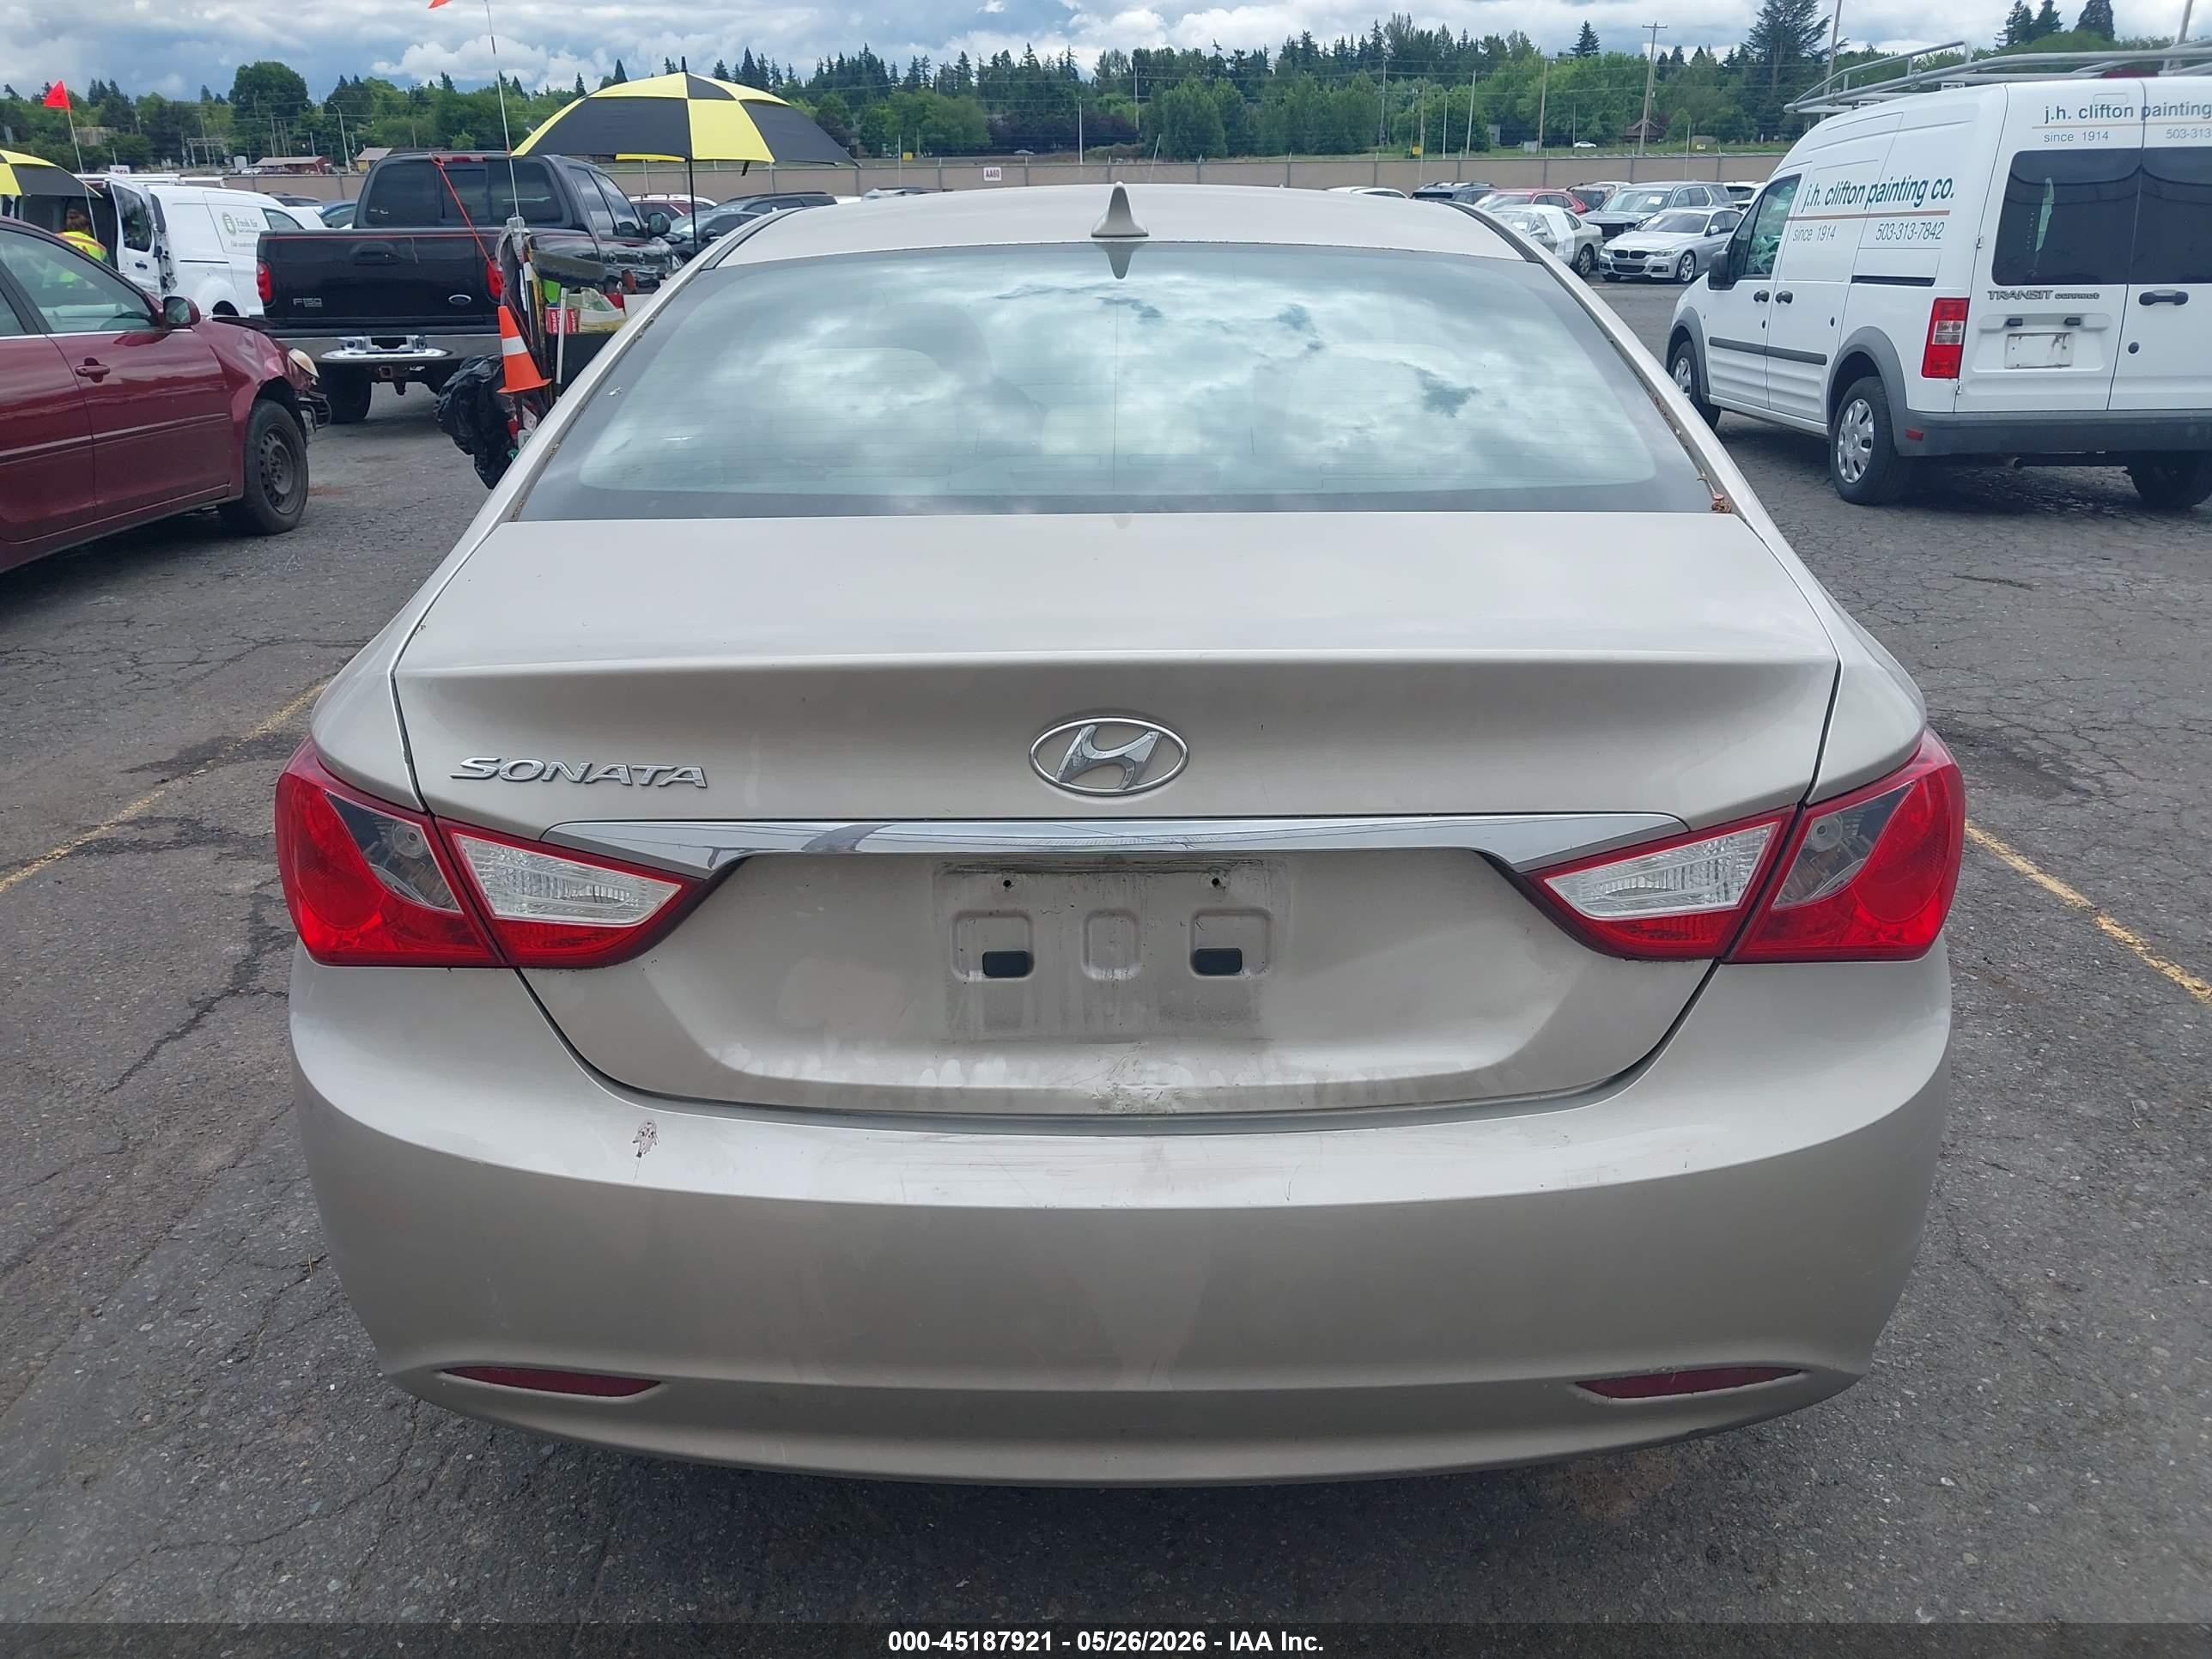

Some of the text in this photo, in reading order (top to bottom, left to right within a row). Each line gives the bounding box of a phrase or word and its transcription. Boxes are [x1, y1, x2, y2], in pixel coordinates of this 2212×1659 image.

[2044, 100, 2212, 124] j.h. clifton painting
[2044, 128, 2212, 143] since 1914 503-313
[1801, 174, 1955, 213] j.h. clifton painting co.
[1792, 221, 1945, 242] since 1914 503-313-7842
[1987, 289, 2053, 301] TRANSIT
[449, 756, 708, 788] SONATA
